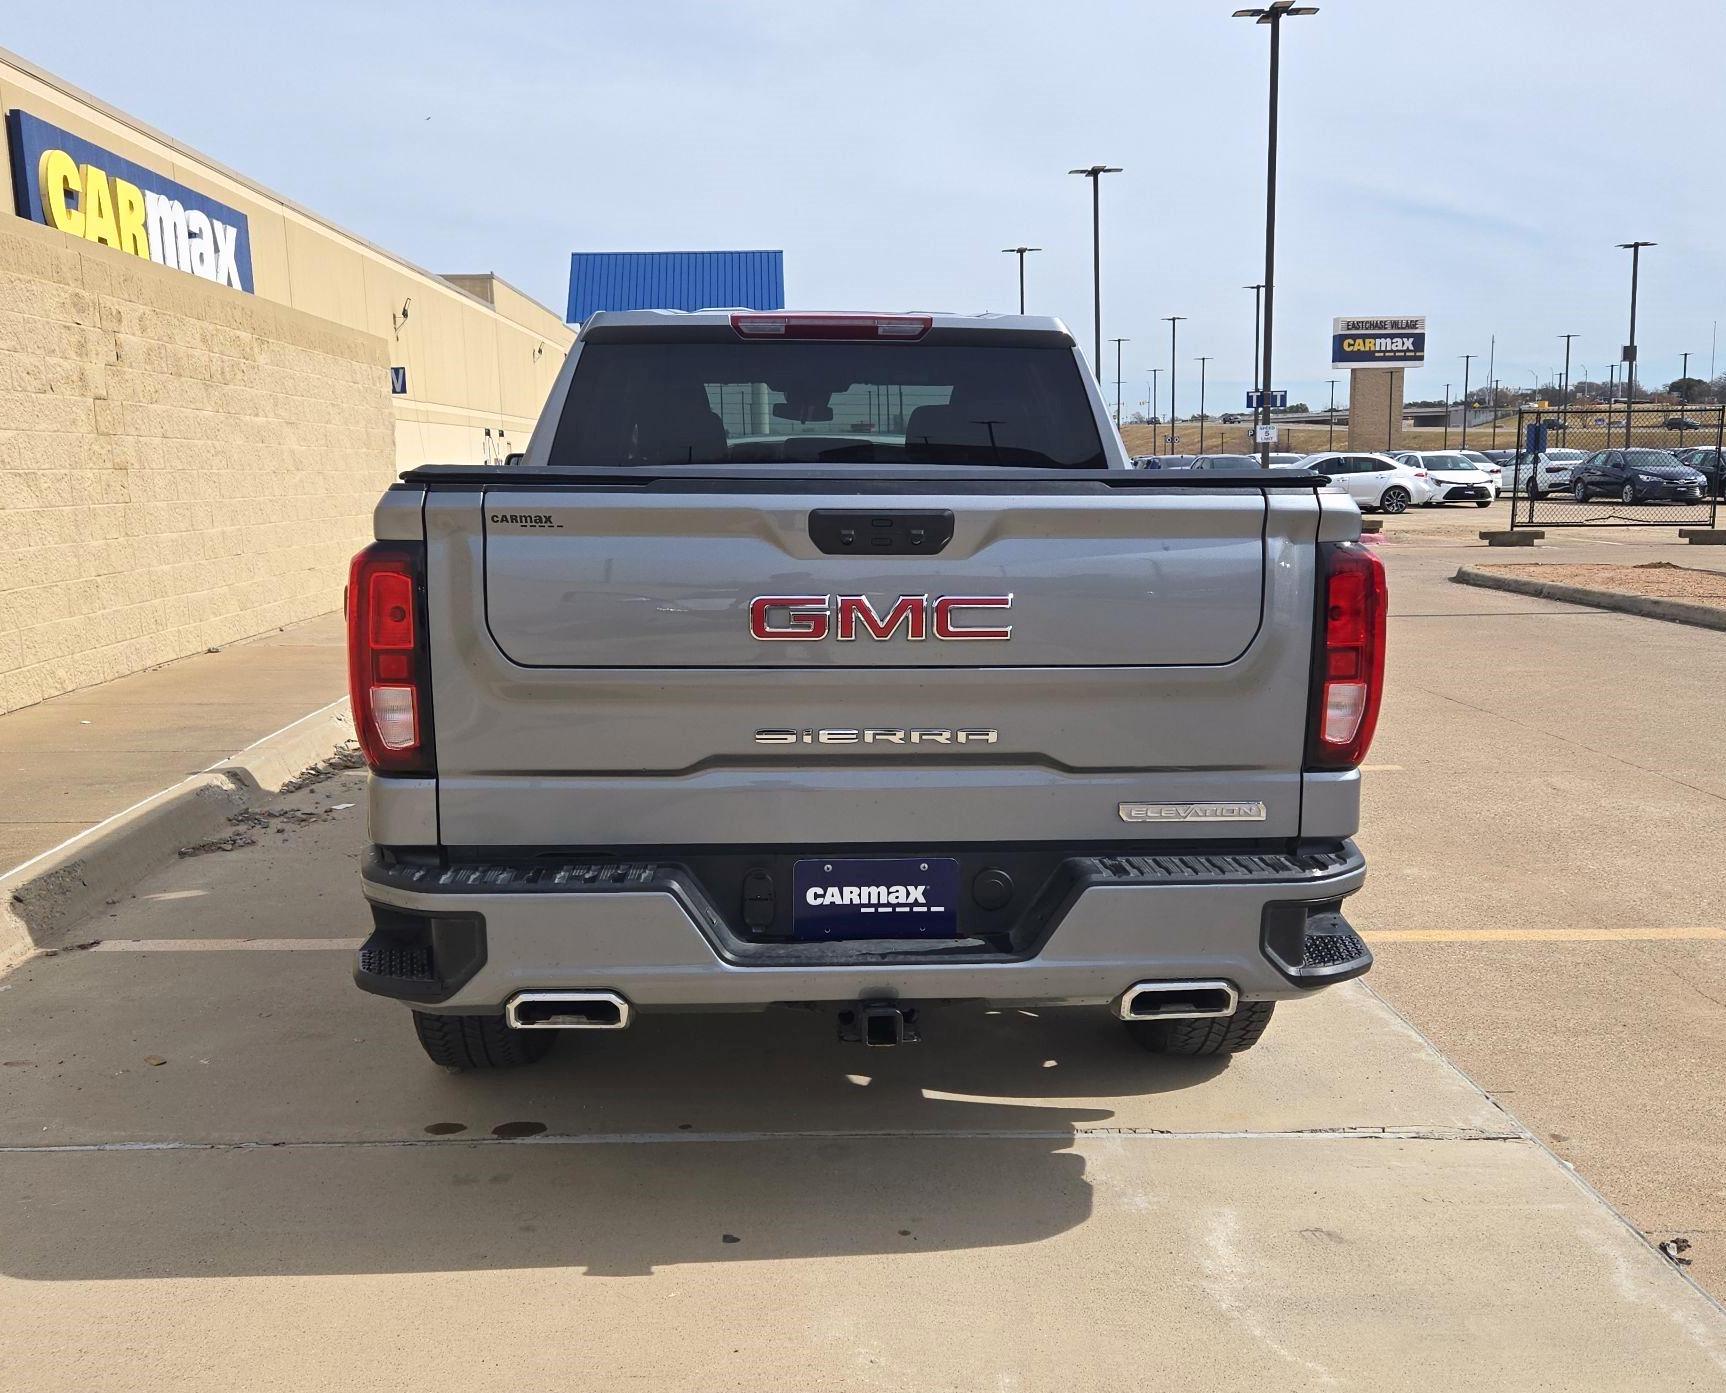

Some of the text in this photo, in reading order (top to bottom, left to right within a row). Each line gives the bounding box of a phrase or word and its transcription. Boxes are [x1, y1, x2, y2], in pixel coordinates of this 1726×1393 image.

[1346, 319, 1419, 331] EASTCHASE VILLAGE
[1343, 337, 1415, 352] CARmax
[490, 514, 553, 524] CARmax
[750, 594, 1013, 641] GMC
[1131, 804, 1258, 819] ELEVATION
[806, 885, 926, 906] CARmax
